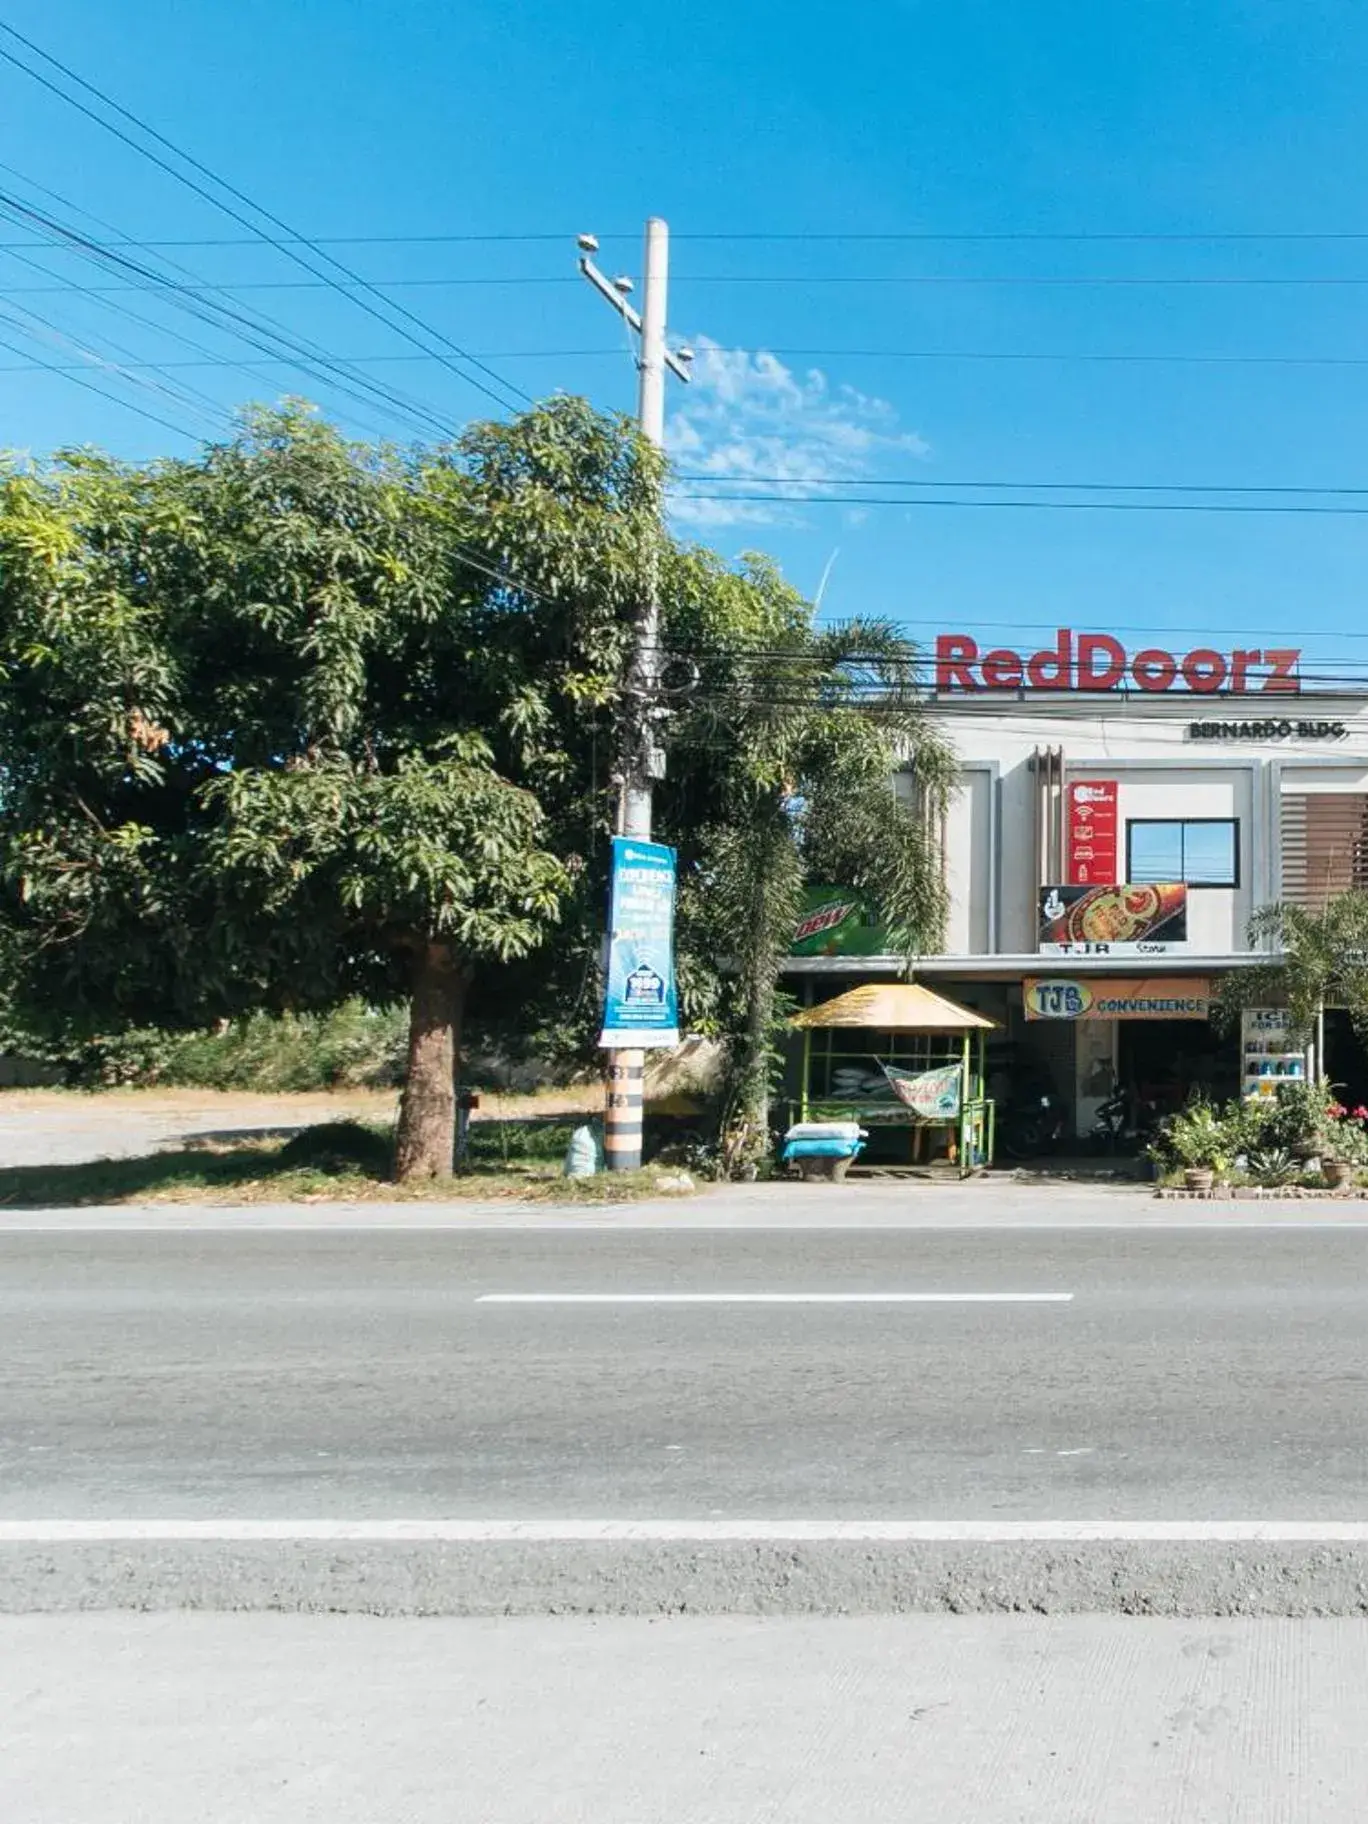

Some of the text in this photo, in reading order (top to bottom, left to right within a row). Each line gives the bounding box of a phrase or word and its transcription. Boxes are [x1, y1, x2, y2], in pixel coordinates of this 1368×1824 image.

[935, 629, 1302, 692] RedDoorz
[1190, 721, 1292, 738] BERNARDO
[1059, 944, 1110, 955] TJR
[1097, 999, 1205, 1014] CONVENIENCE
